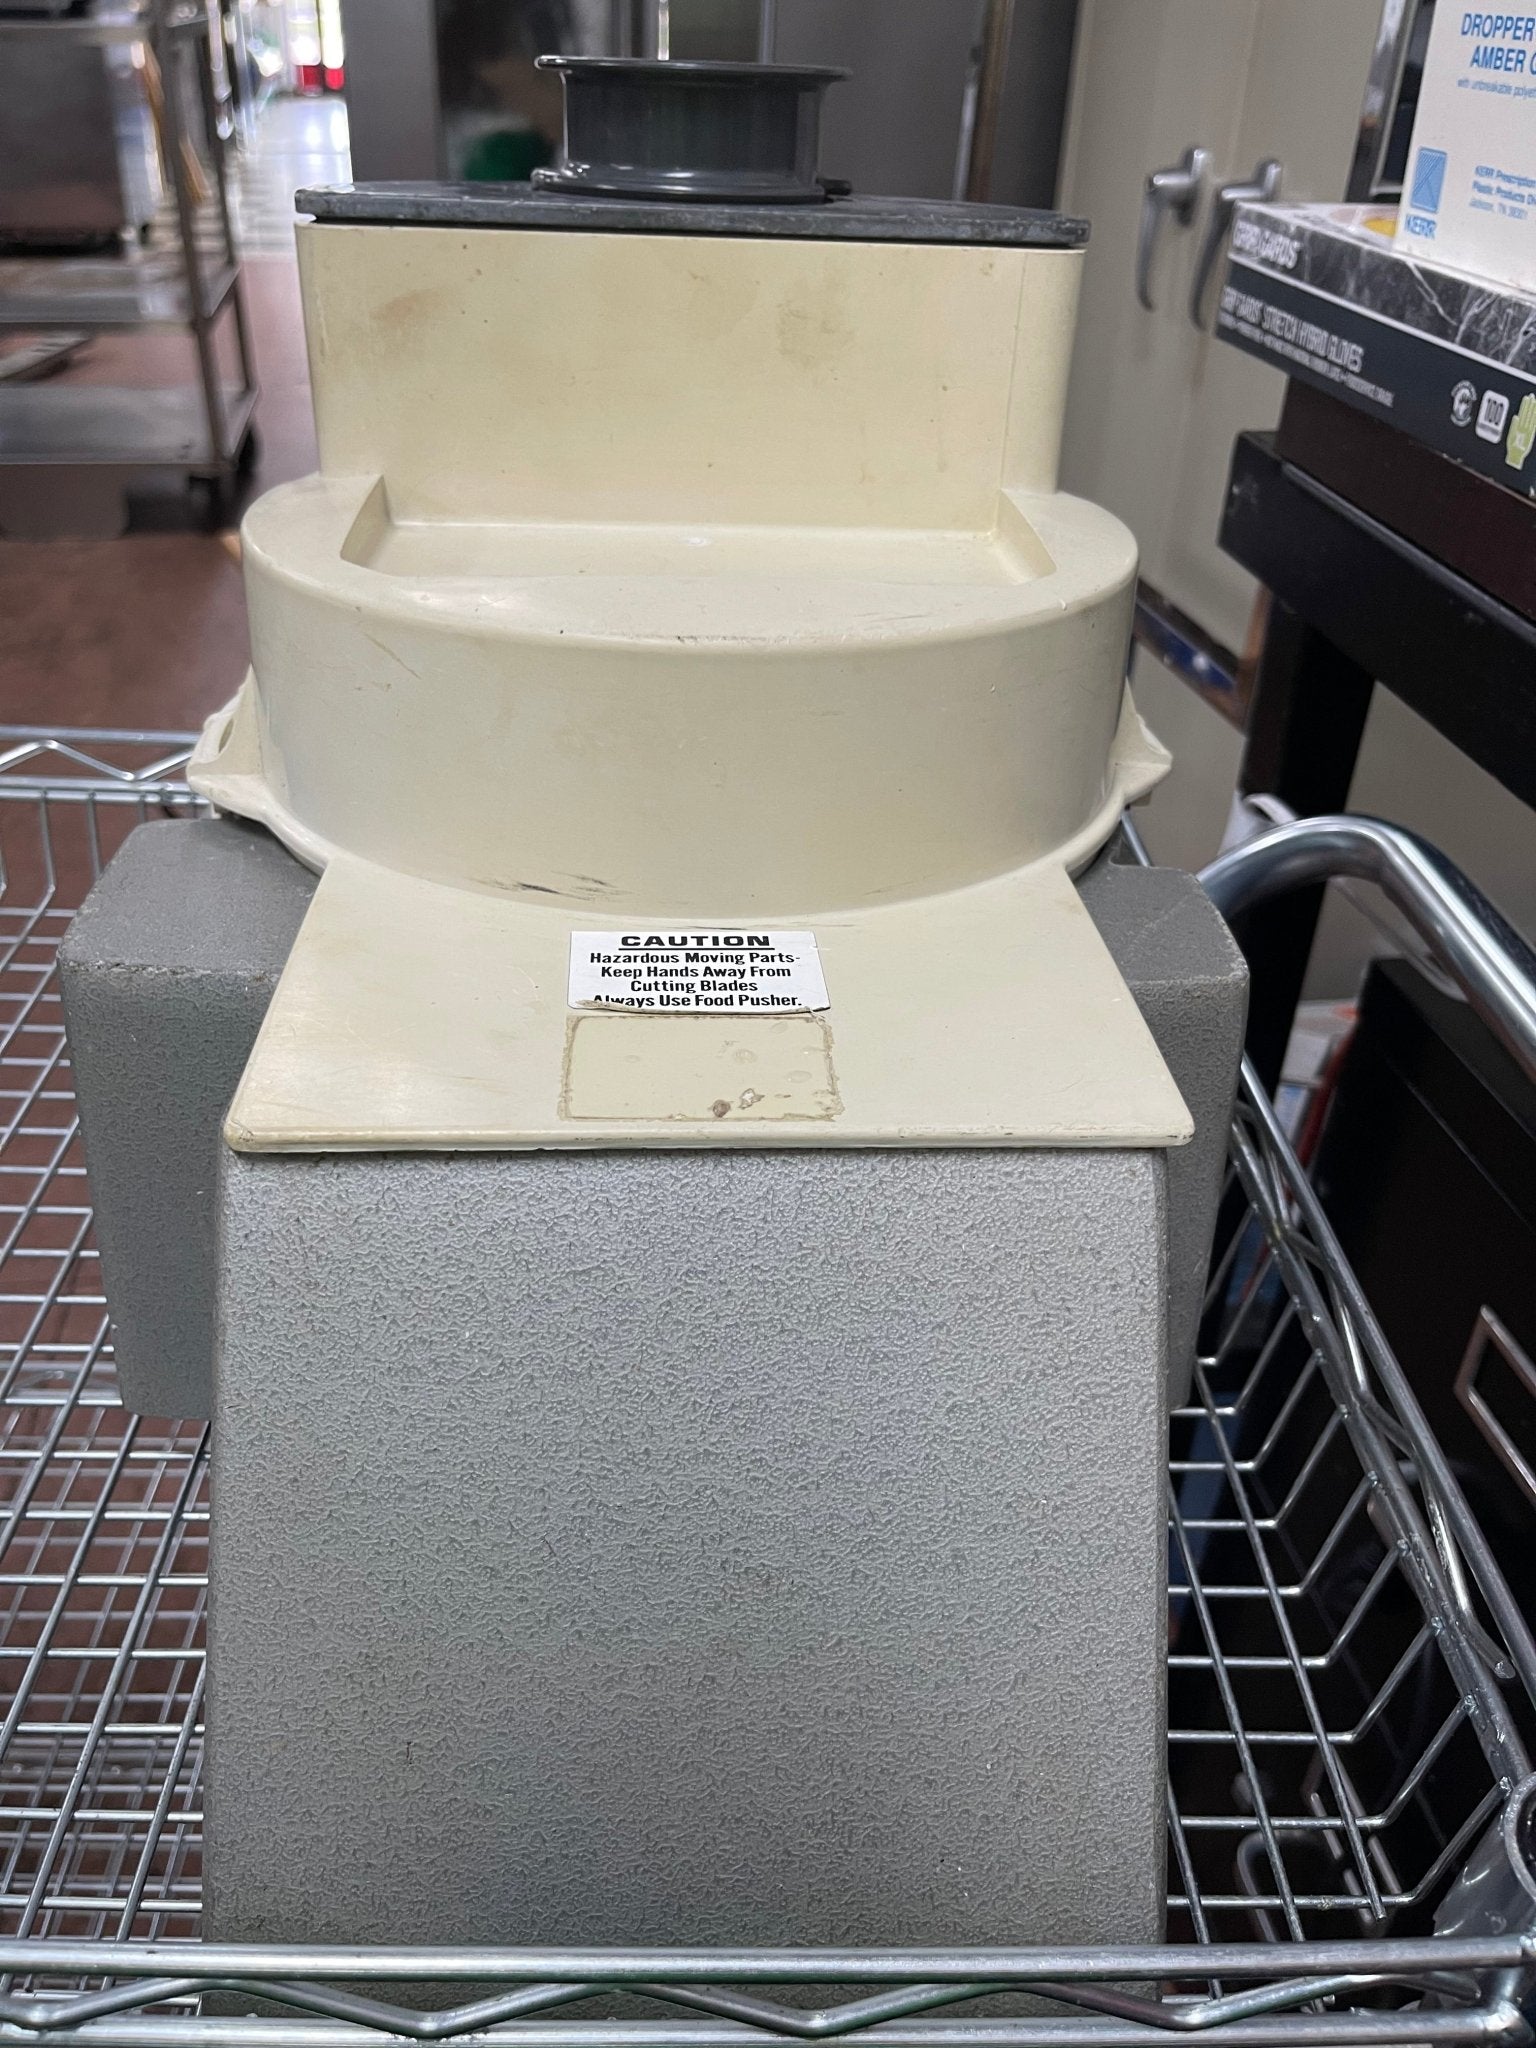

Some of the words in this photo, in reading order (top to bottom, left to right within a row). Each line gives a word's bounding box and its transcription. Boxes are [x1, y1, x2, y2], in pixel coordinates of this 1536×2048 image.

[1461, 13, 1536, 42] DROPPER
[1470, 45, 1526, 73] AMBER
[621, 935, 770, 947] CAUTION
[590, 952, 680, 963] Hazardous
[685, 952, 745, 965] Moving
[601, 966, 643, 979] Keep
[646, 966, 699, 977] Hands
[703, 966, 746, 979] Away
[750, 966, 792, 977] From
[630, 980, 696, 994] Cutting
[700, 980, 758, 992] Blades
[594, 994, 655, 1008] Always
[659, 994, 691, 1007] Use
[695, 994, 734, 1007] Food
[738, 993, 803, 1007] Pusher.
